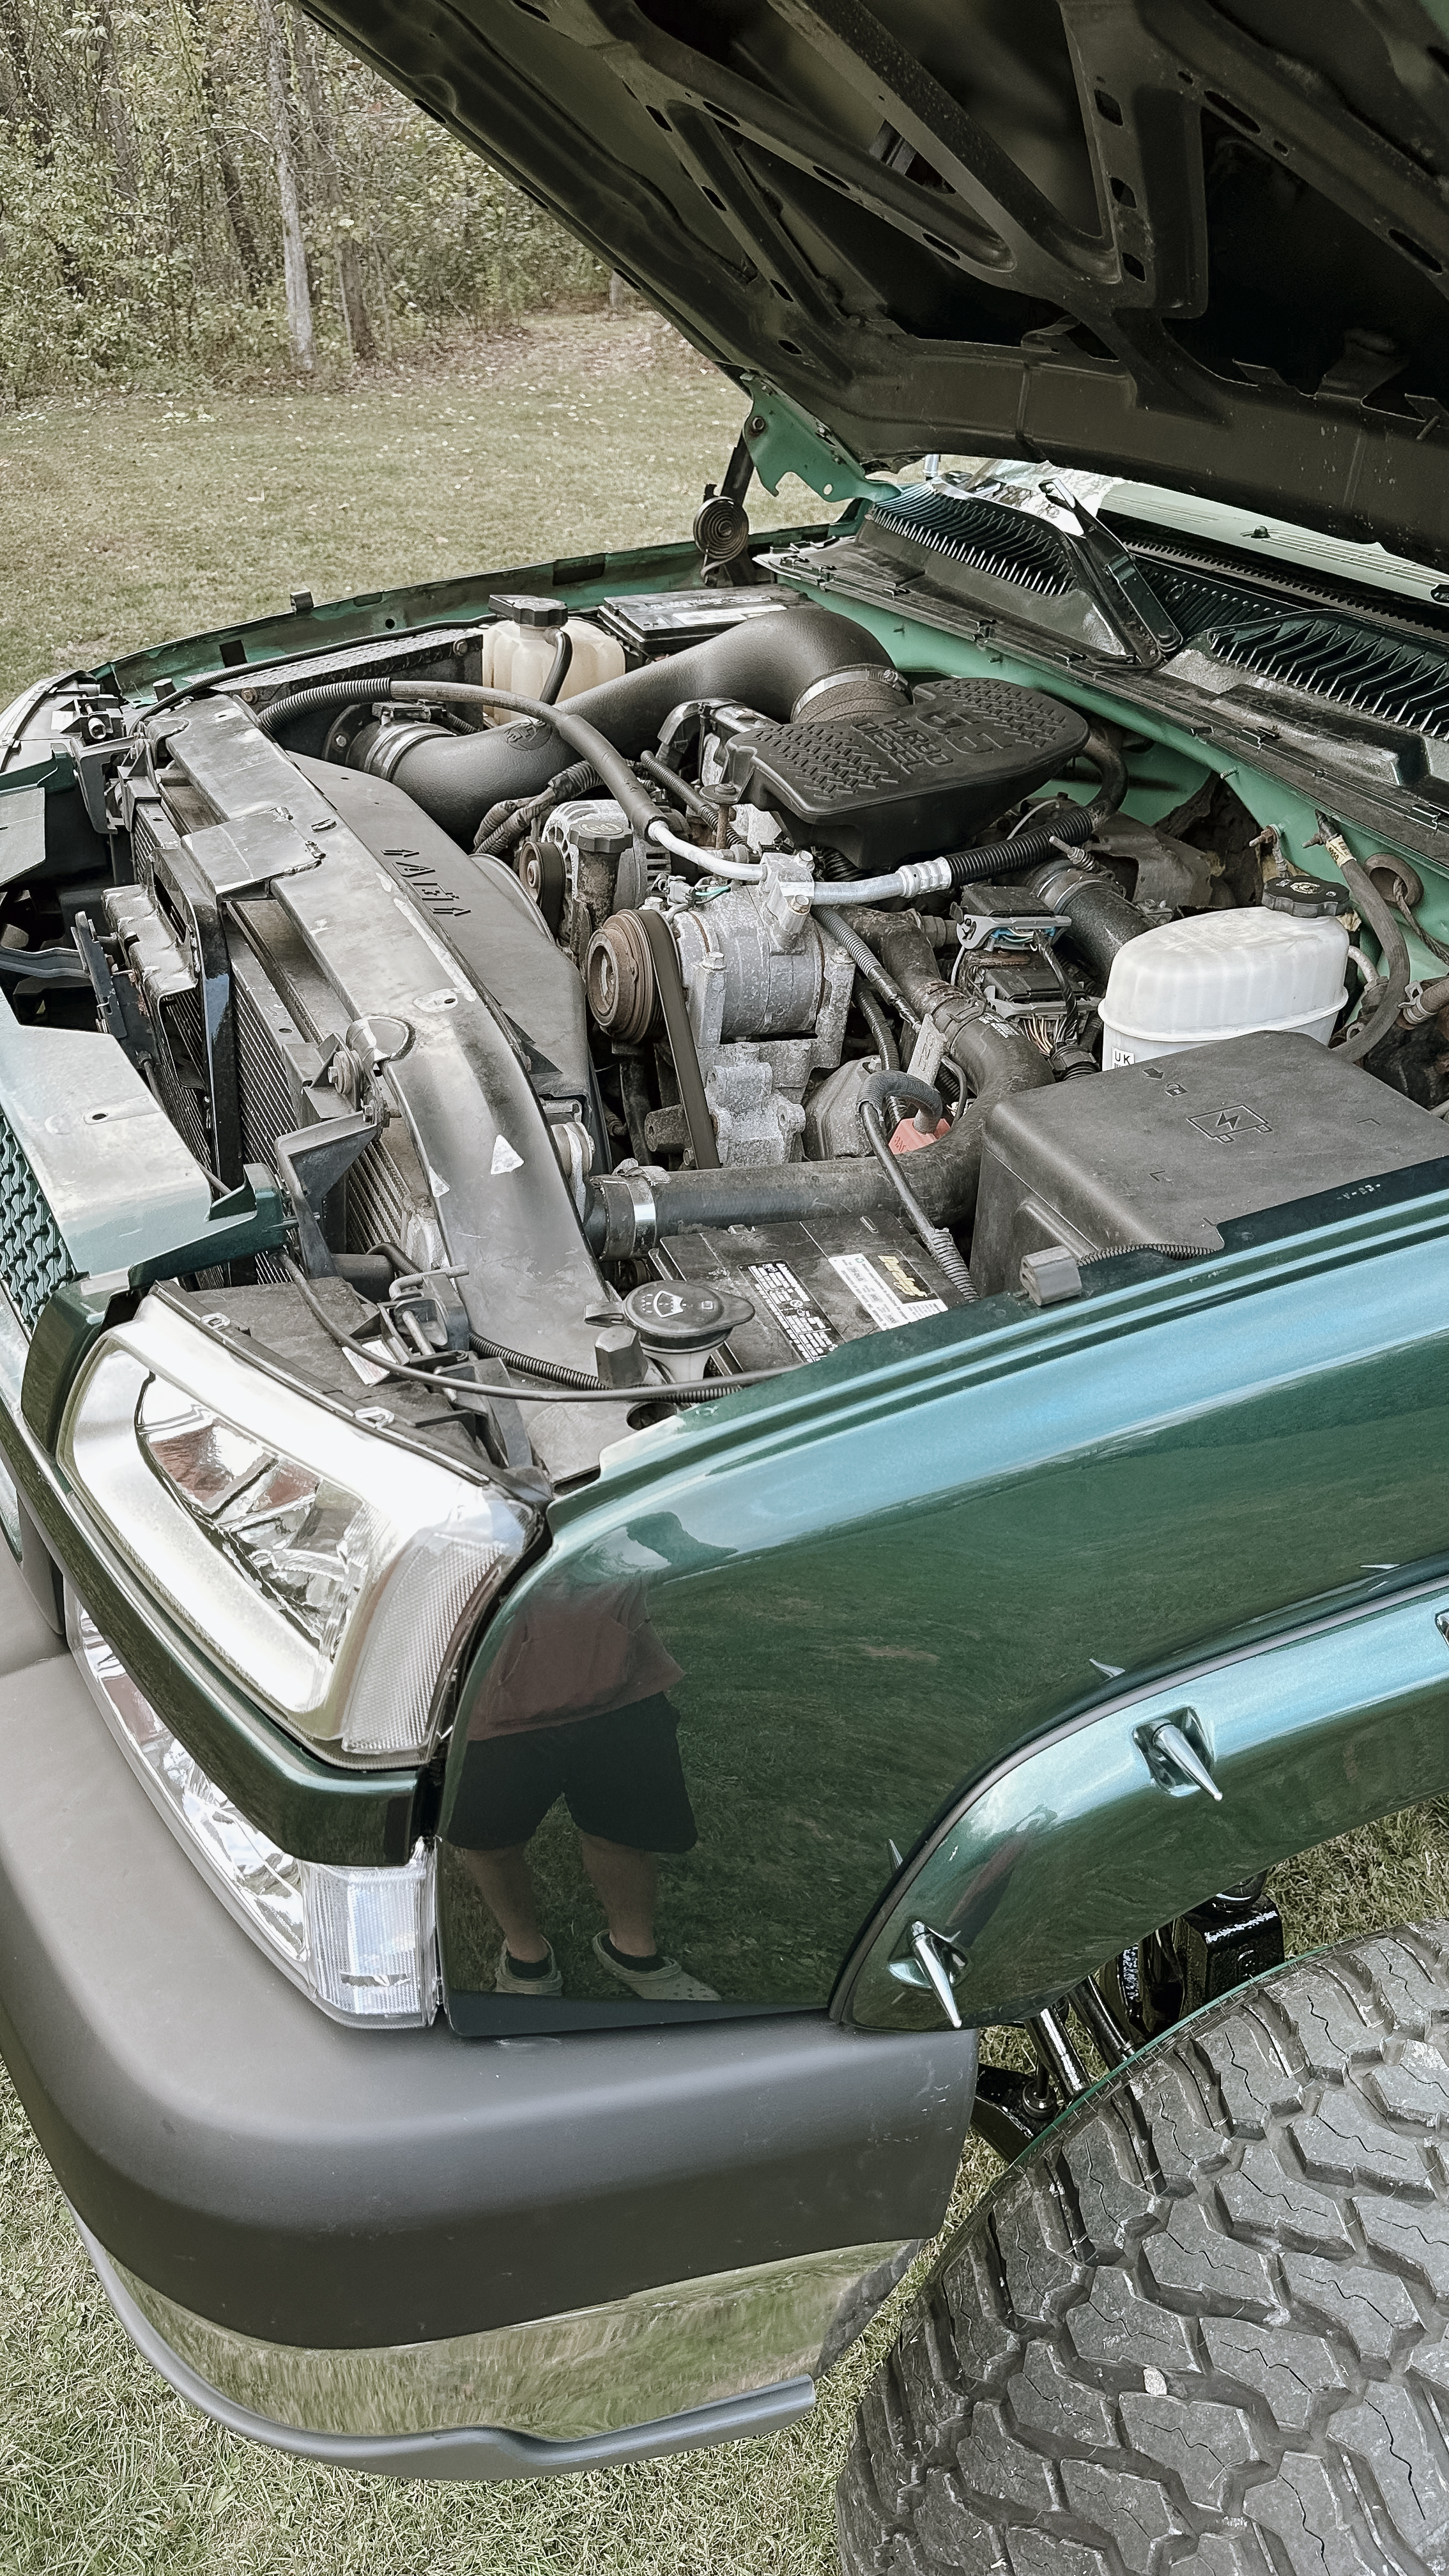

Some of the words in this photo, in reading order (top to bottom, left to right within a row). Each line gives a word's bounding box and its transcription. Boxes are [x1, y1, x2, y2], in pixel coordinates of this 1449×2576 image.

[850, 721, 924, 775] DIESEL
[882, 717, 954, 767] TURBO
[1114, 1050, 1131, 1066] UK
